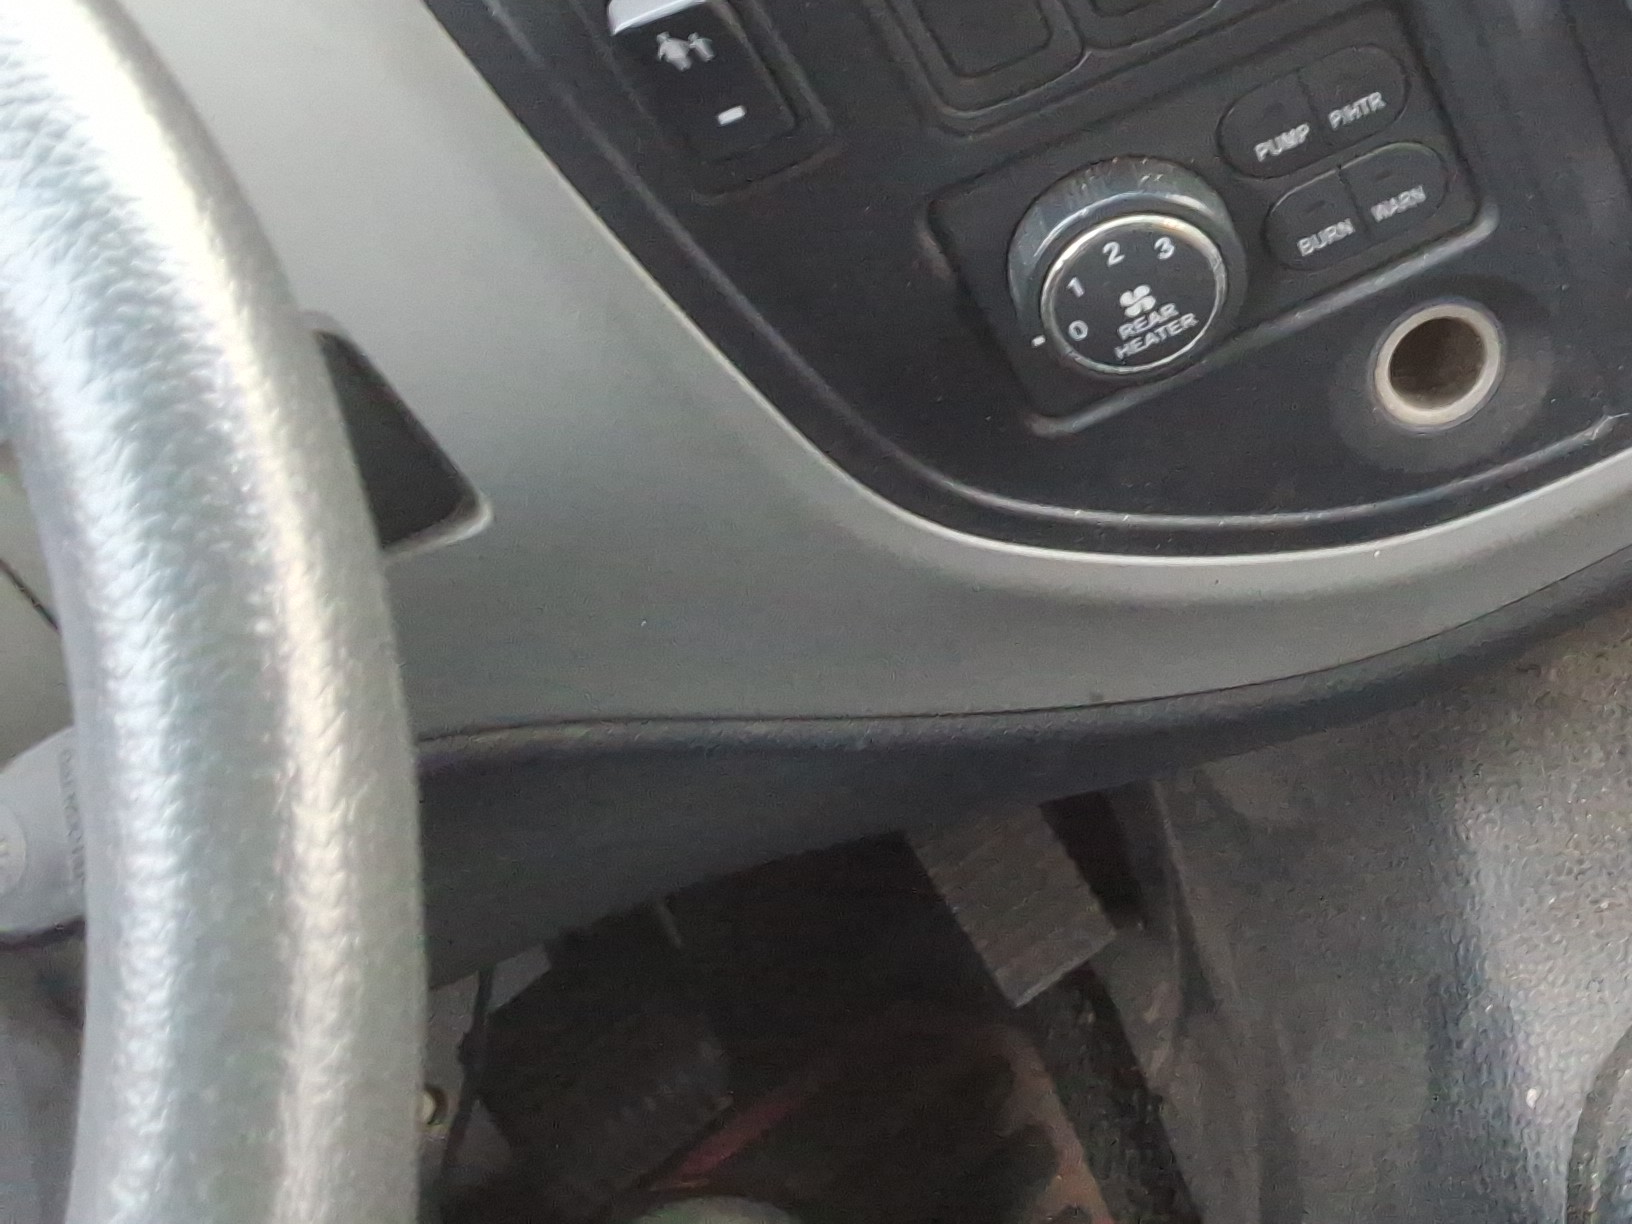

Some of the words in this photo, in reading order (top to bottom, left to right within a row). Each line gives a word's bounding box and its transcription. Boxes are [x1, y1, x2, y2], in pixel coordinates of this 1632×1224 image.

[1254, 123, 1310, 162] PUMP
[1370, 185, 1426, 222] WARN
[1103, 241, 1125, 267] 2
[1155, 237, 1175, 260] 3
[1297, 218, 1355, 257] BURN
[1067, 277, 1085, 297] 1
[1068, 320, 1088, 341] 0
[1114, 312, 1199, 360] HEATER
[1118, 303, 1179, 340] REAR
